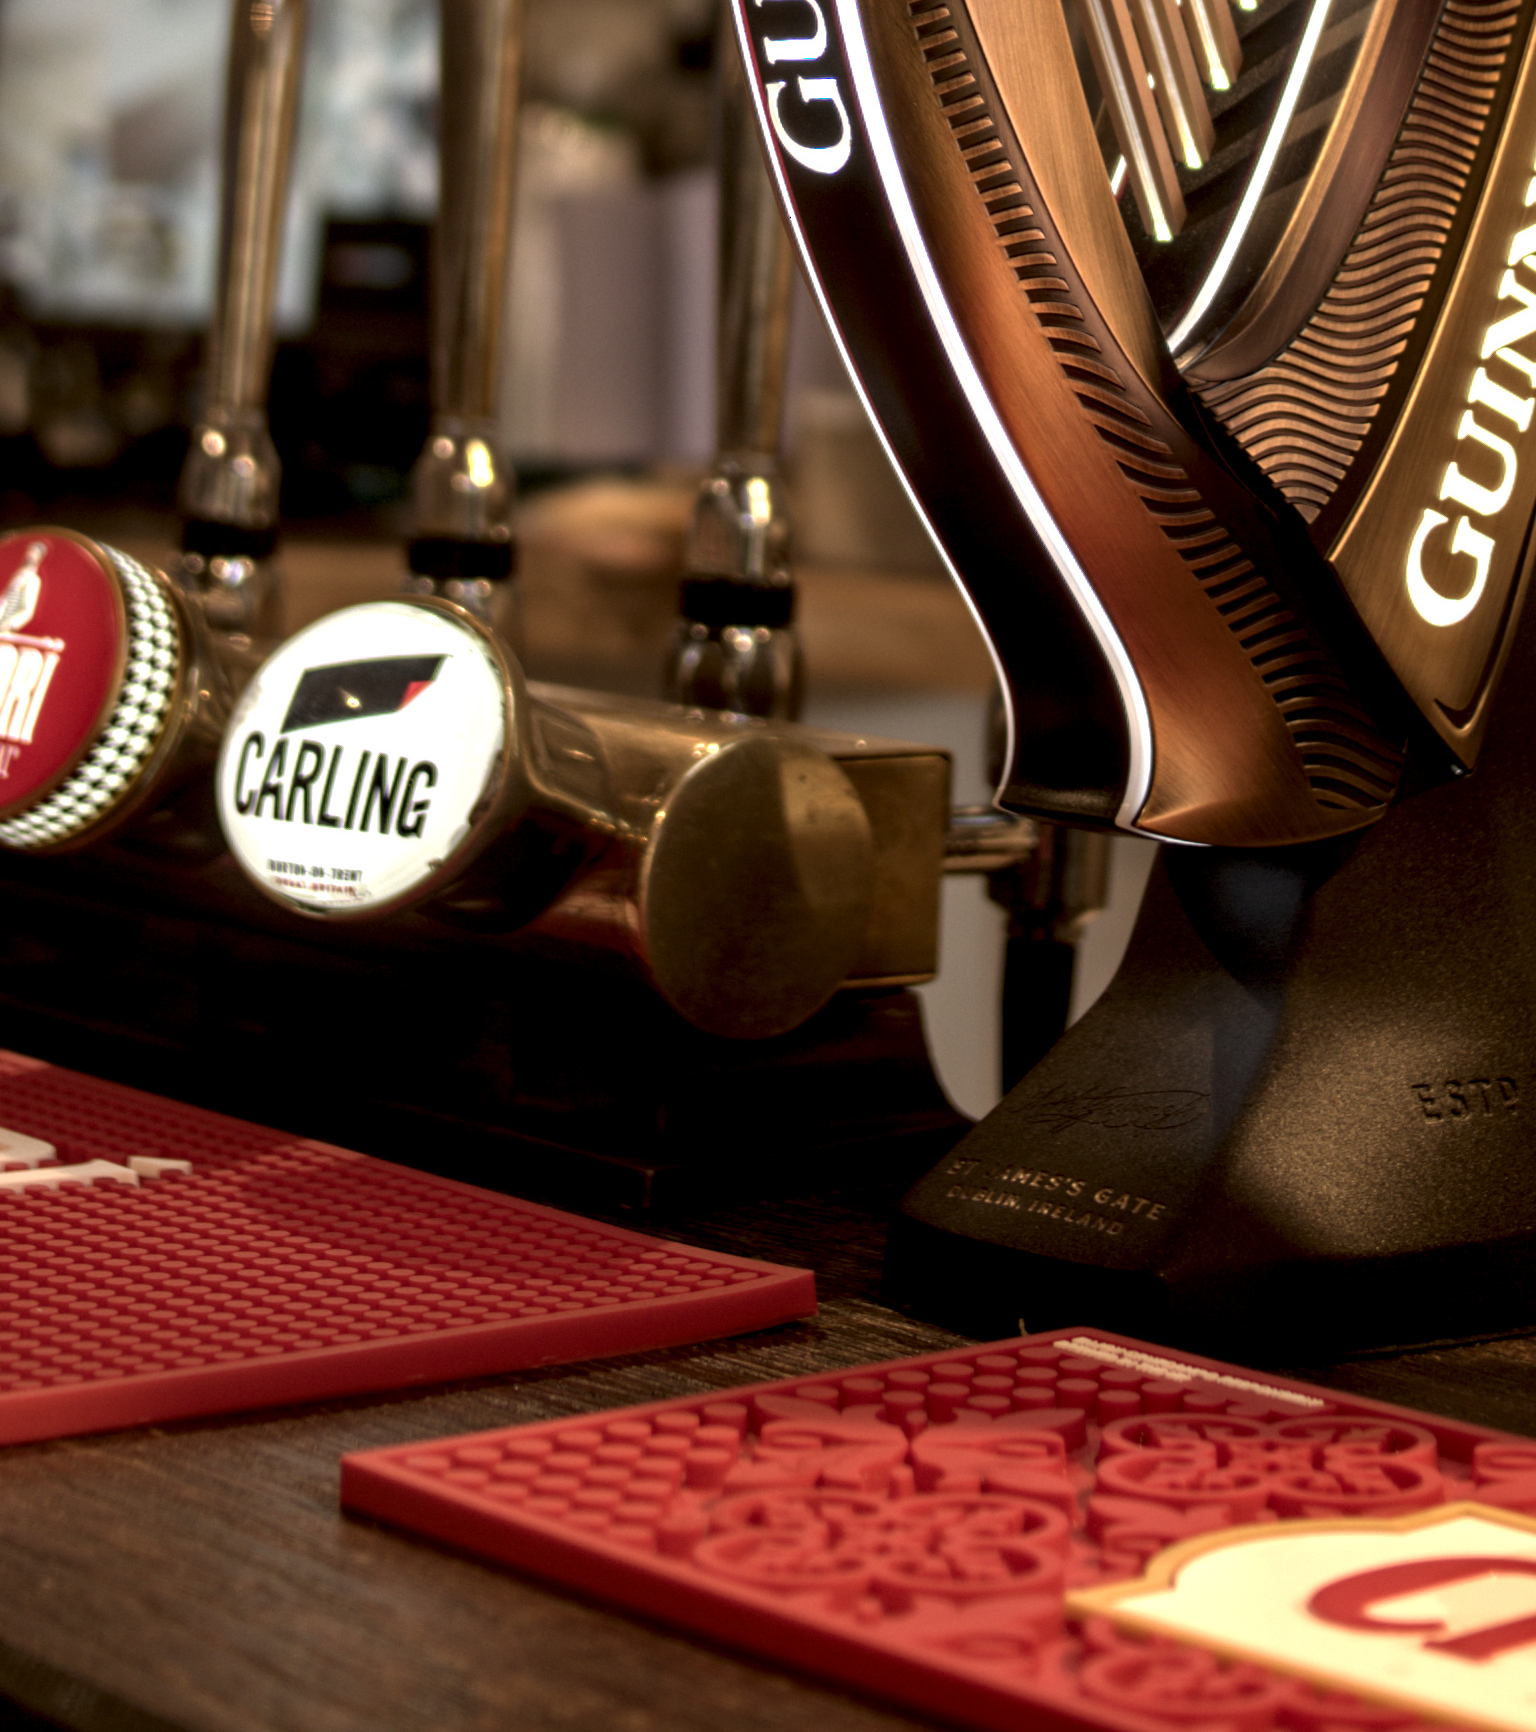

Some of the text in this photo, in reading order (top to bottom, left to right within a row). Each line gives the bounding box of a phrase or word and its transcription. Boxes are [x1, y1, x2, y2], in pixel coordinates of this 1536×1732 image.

[234, 730, 439, 840] CARLING
[983, 1161, 1088, 1197] JAMES'S
[1093, 1184, 1167, 1221] GATE
[1026, 1199, 1126, 1236] IRELAND
